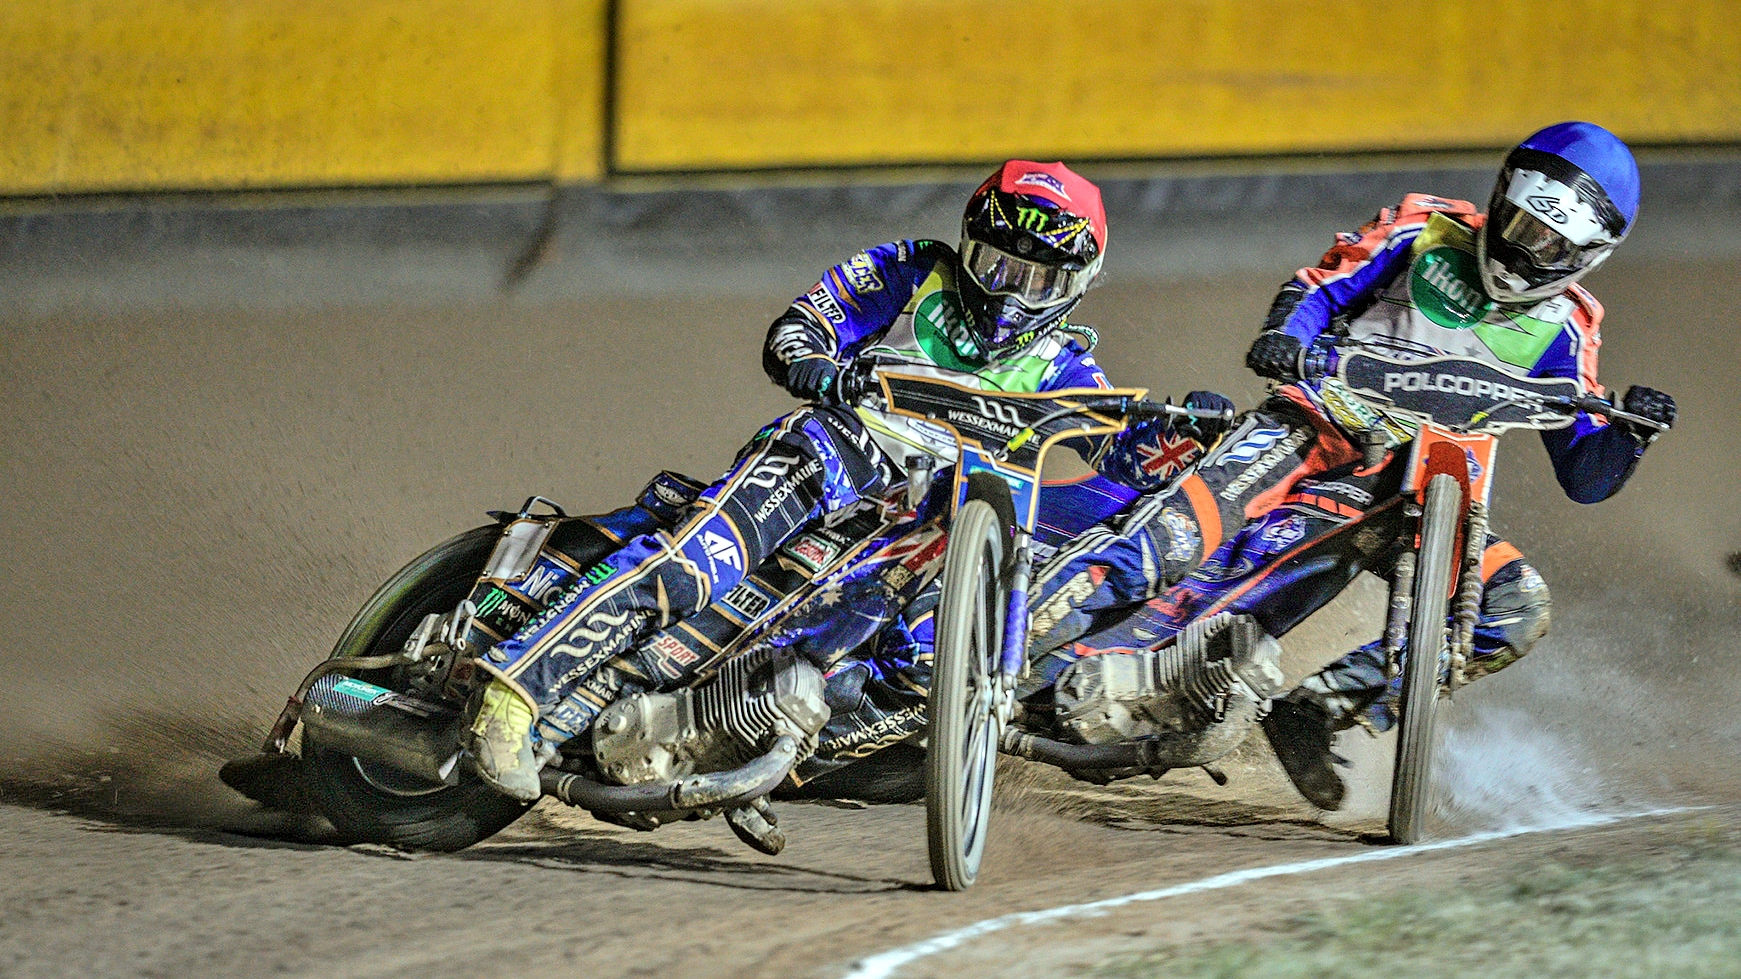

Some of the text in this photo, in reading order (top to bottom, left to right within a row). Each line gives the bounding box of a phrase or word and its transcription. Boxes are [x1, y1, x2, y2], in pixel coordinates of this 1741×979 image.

[947, 408, 1042, 445] WESSEXMARE
[728, 584, 766, 618] ILTER
[657, 635, 697, 667] SPORT
